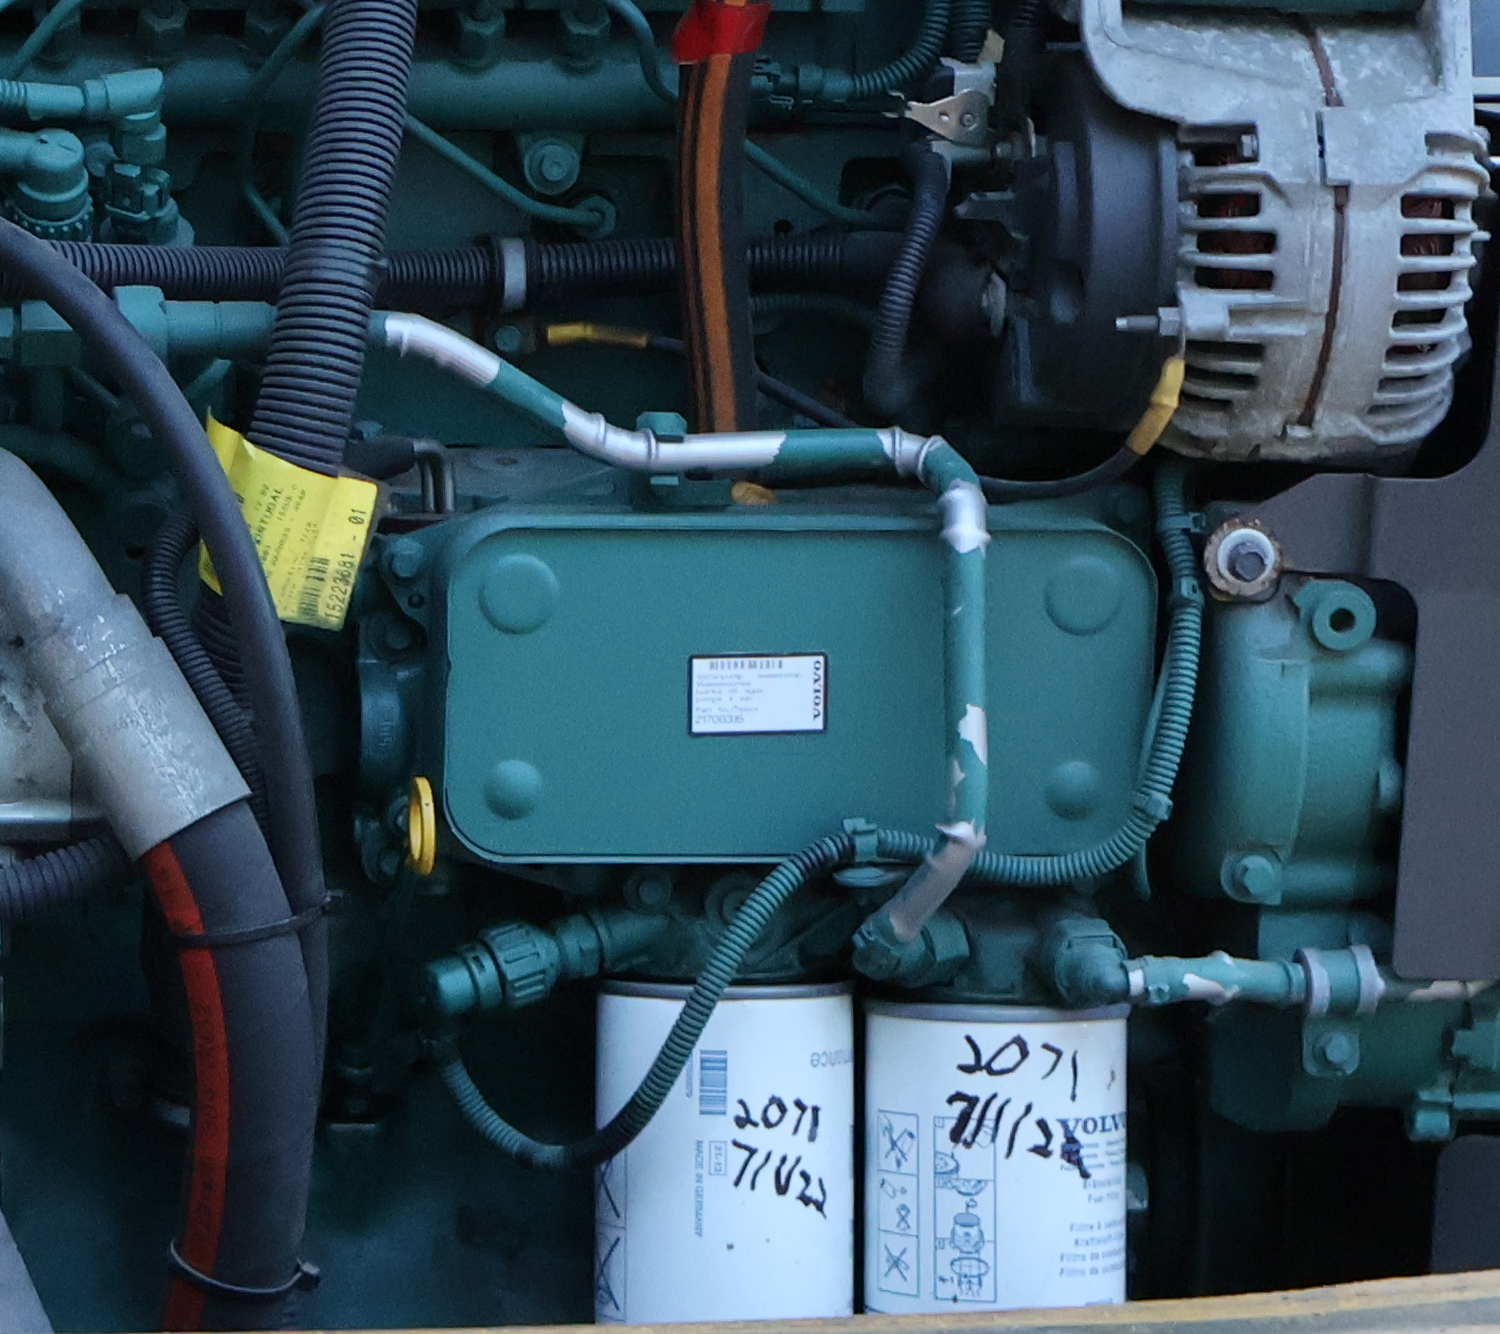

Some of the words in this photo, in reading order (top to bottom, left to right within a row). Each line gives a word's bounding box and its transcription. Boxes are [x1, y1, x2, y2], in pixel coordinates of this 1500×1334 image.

[812, 659, 823, 722] VOLVO
[732, 1094, 822, 1143] 2071
[1056, 1112, 1126, 1134] VOLV
